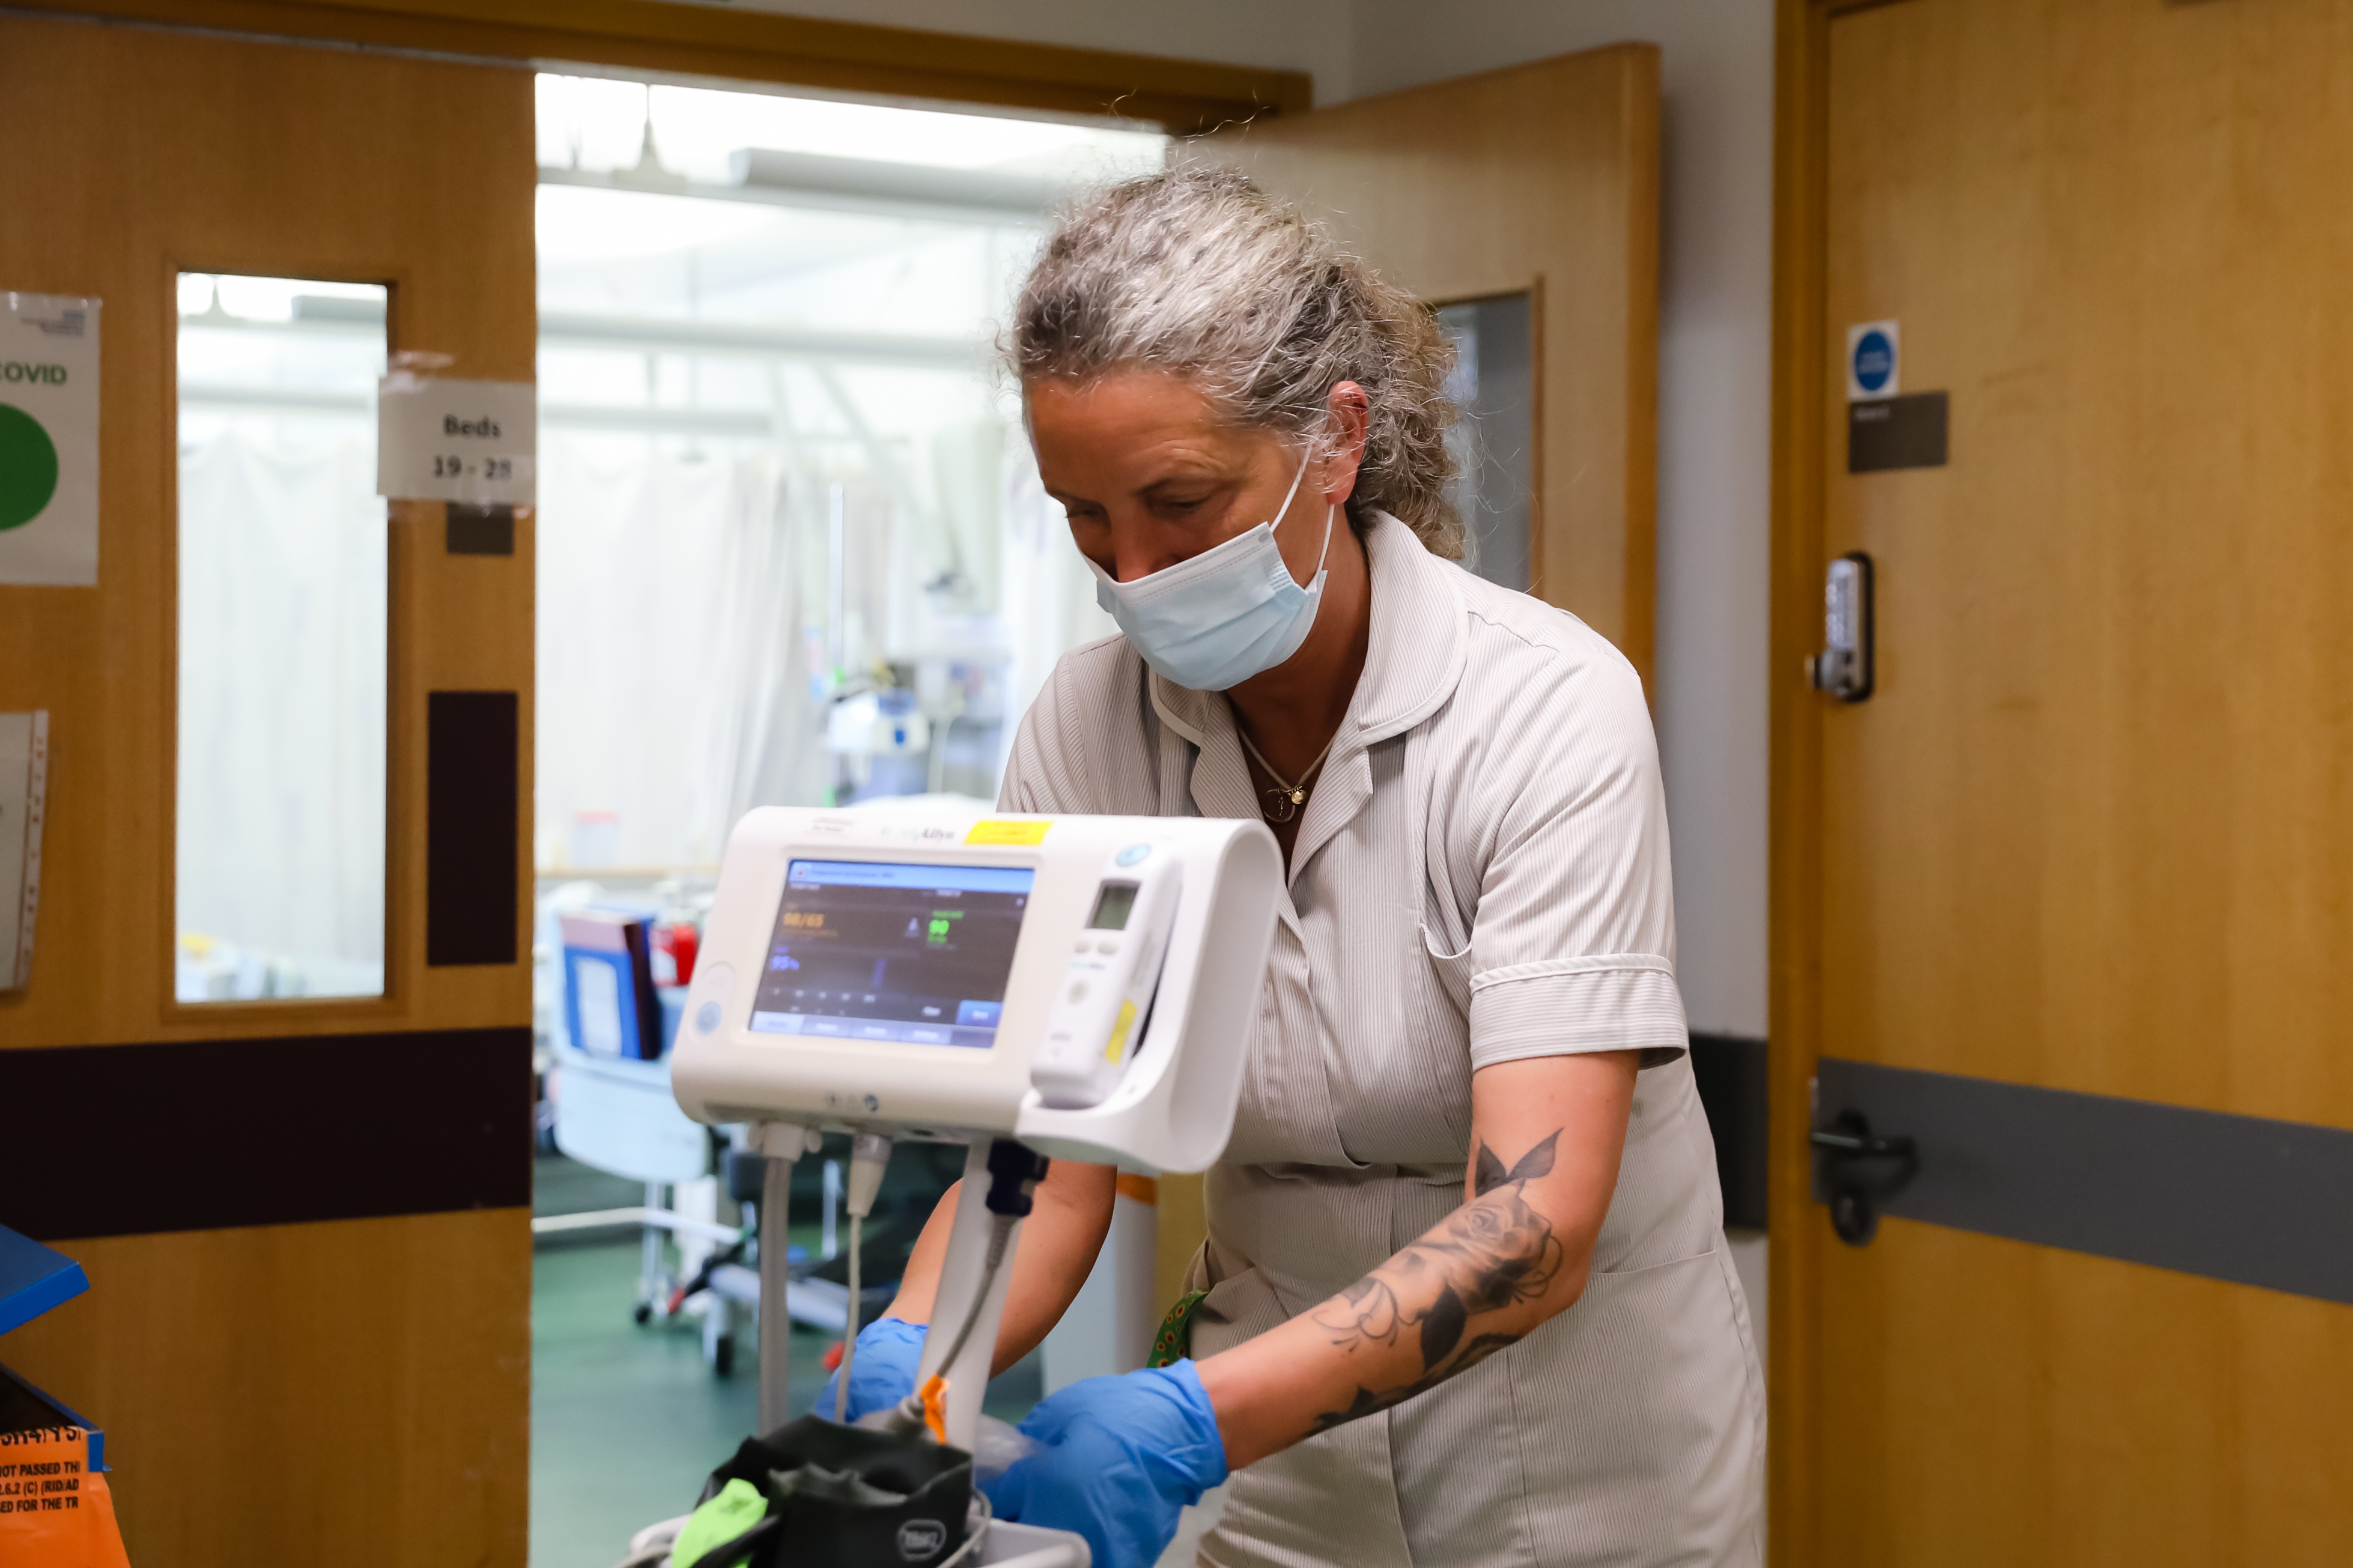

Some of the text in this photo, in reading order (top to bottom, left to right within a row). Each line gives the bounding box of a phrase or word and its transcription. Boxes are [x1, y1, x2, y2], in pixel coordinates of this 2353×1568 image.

[0, 362, 67, 386] OVID
[443, 414, 502, 438] Beds
[436, 455, 462, 479] 19
[20, 1462, 61, 1477] PASSED
[23, 1481, 37, 1497] (C)
[17, 1499, 37, 1512] FOR
[41, 1497, 62, 1510] THE
